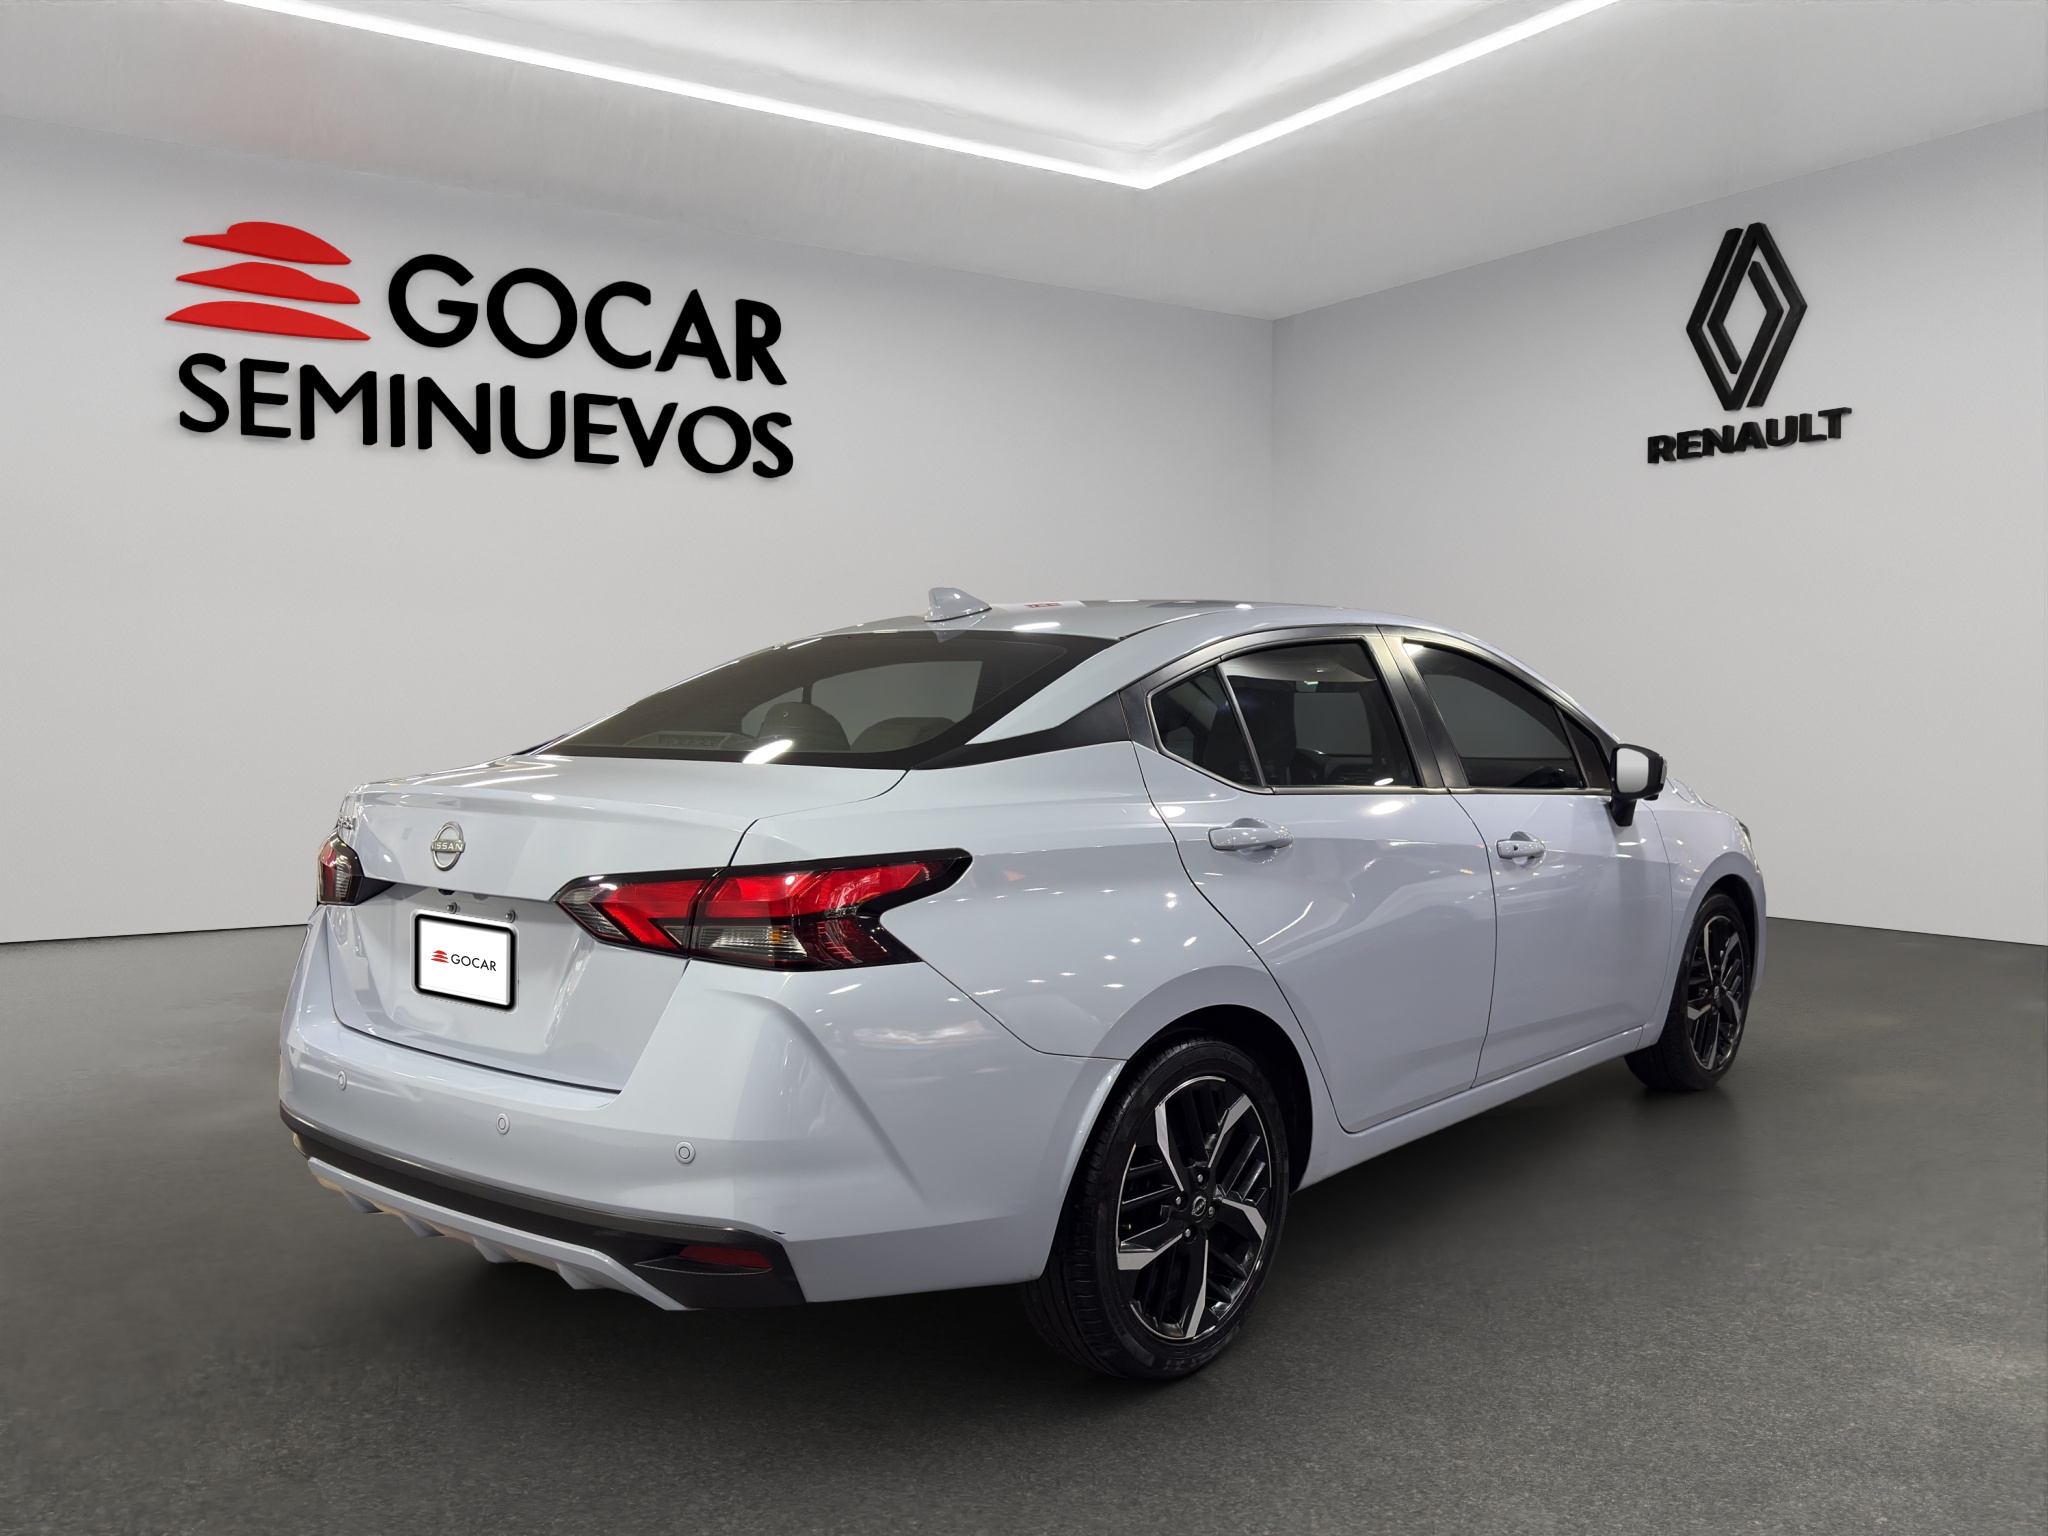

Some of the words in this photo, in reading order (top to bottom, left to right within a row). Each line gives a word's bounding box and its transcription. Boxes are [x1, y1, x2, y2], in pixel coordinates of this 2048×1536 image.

[387, 253, 789, 386] GOCAR
[178, 352, 795, 479] SEMINUEVOS
[1647, 407, 1853, 464] RENAULT
[450, 953, 497, 972] GOCAR
